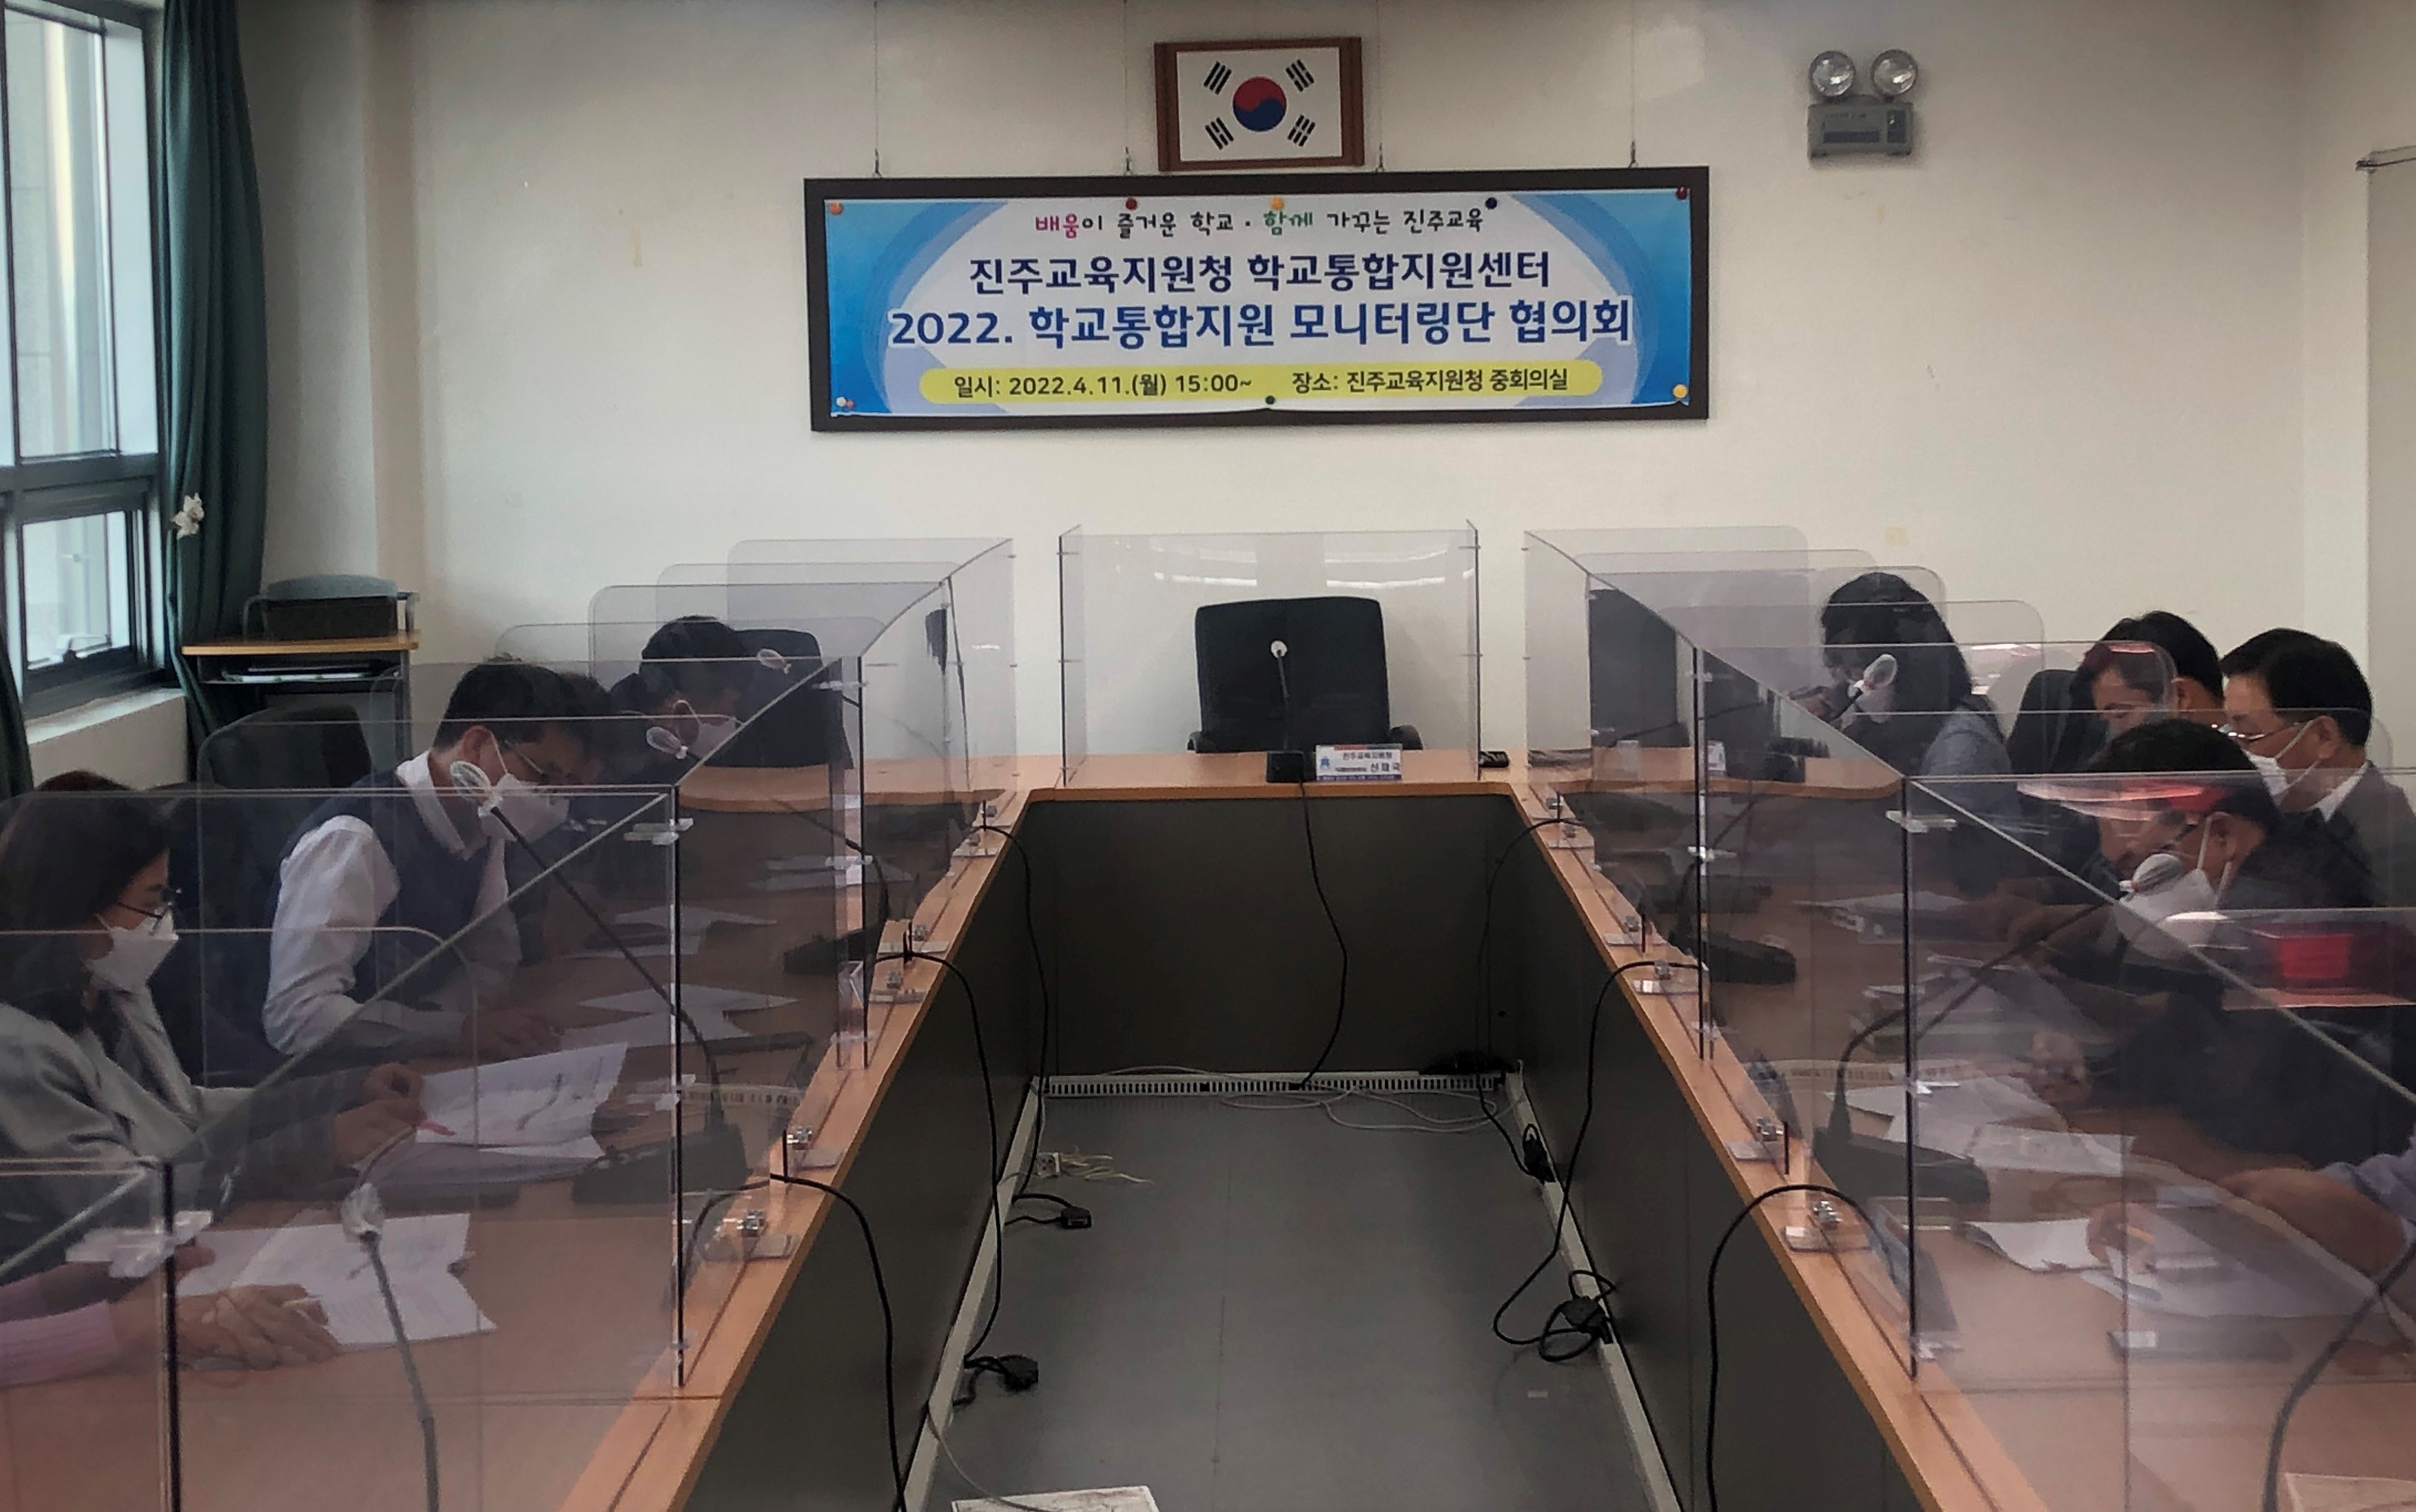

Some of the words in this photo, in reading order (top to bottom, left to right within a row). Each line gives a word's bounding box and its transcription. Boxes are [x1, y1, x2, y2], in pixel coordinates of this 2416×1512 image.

[1035, 213, 1103, 239] 배움이
[1117, 212, 1177, 239] 즐거운
[1190, 211, 1234, 236] 학교
[1263, 209, 1313, 235] 함께
[1327, 211, 1390, 234] 가꾸는
[1404, 208, 1483, 233] 진주교육
[969, 255, 1232, 294] 진주교육지원청
[1247, 251, 1549, 291] 학교통합지원센터
[891, 312, 1014, 345] 2022.
[1029, 304, 1274, 350] 학교통합지원
[1290, 301, 1496, 346] 모니터링단
[1509, 298, 1629, 344] 협의회
[954, 375, 1001, 398] 일시:
[1009, 374, 1167, 398] 2022.4.11.(월)
[1176, 374, 1253, 393] 15:00~
[1292, 372, 1339, 394] 장소:
[1346, 370, 1483, 392] 진주교육지원청
[1489, 368, 1568, 391] 중회의실
